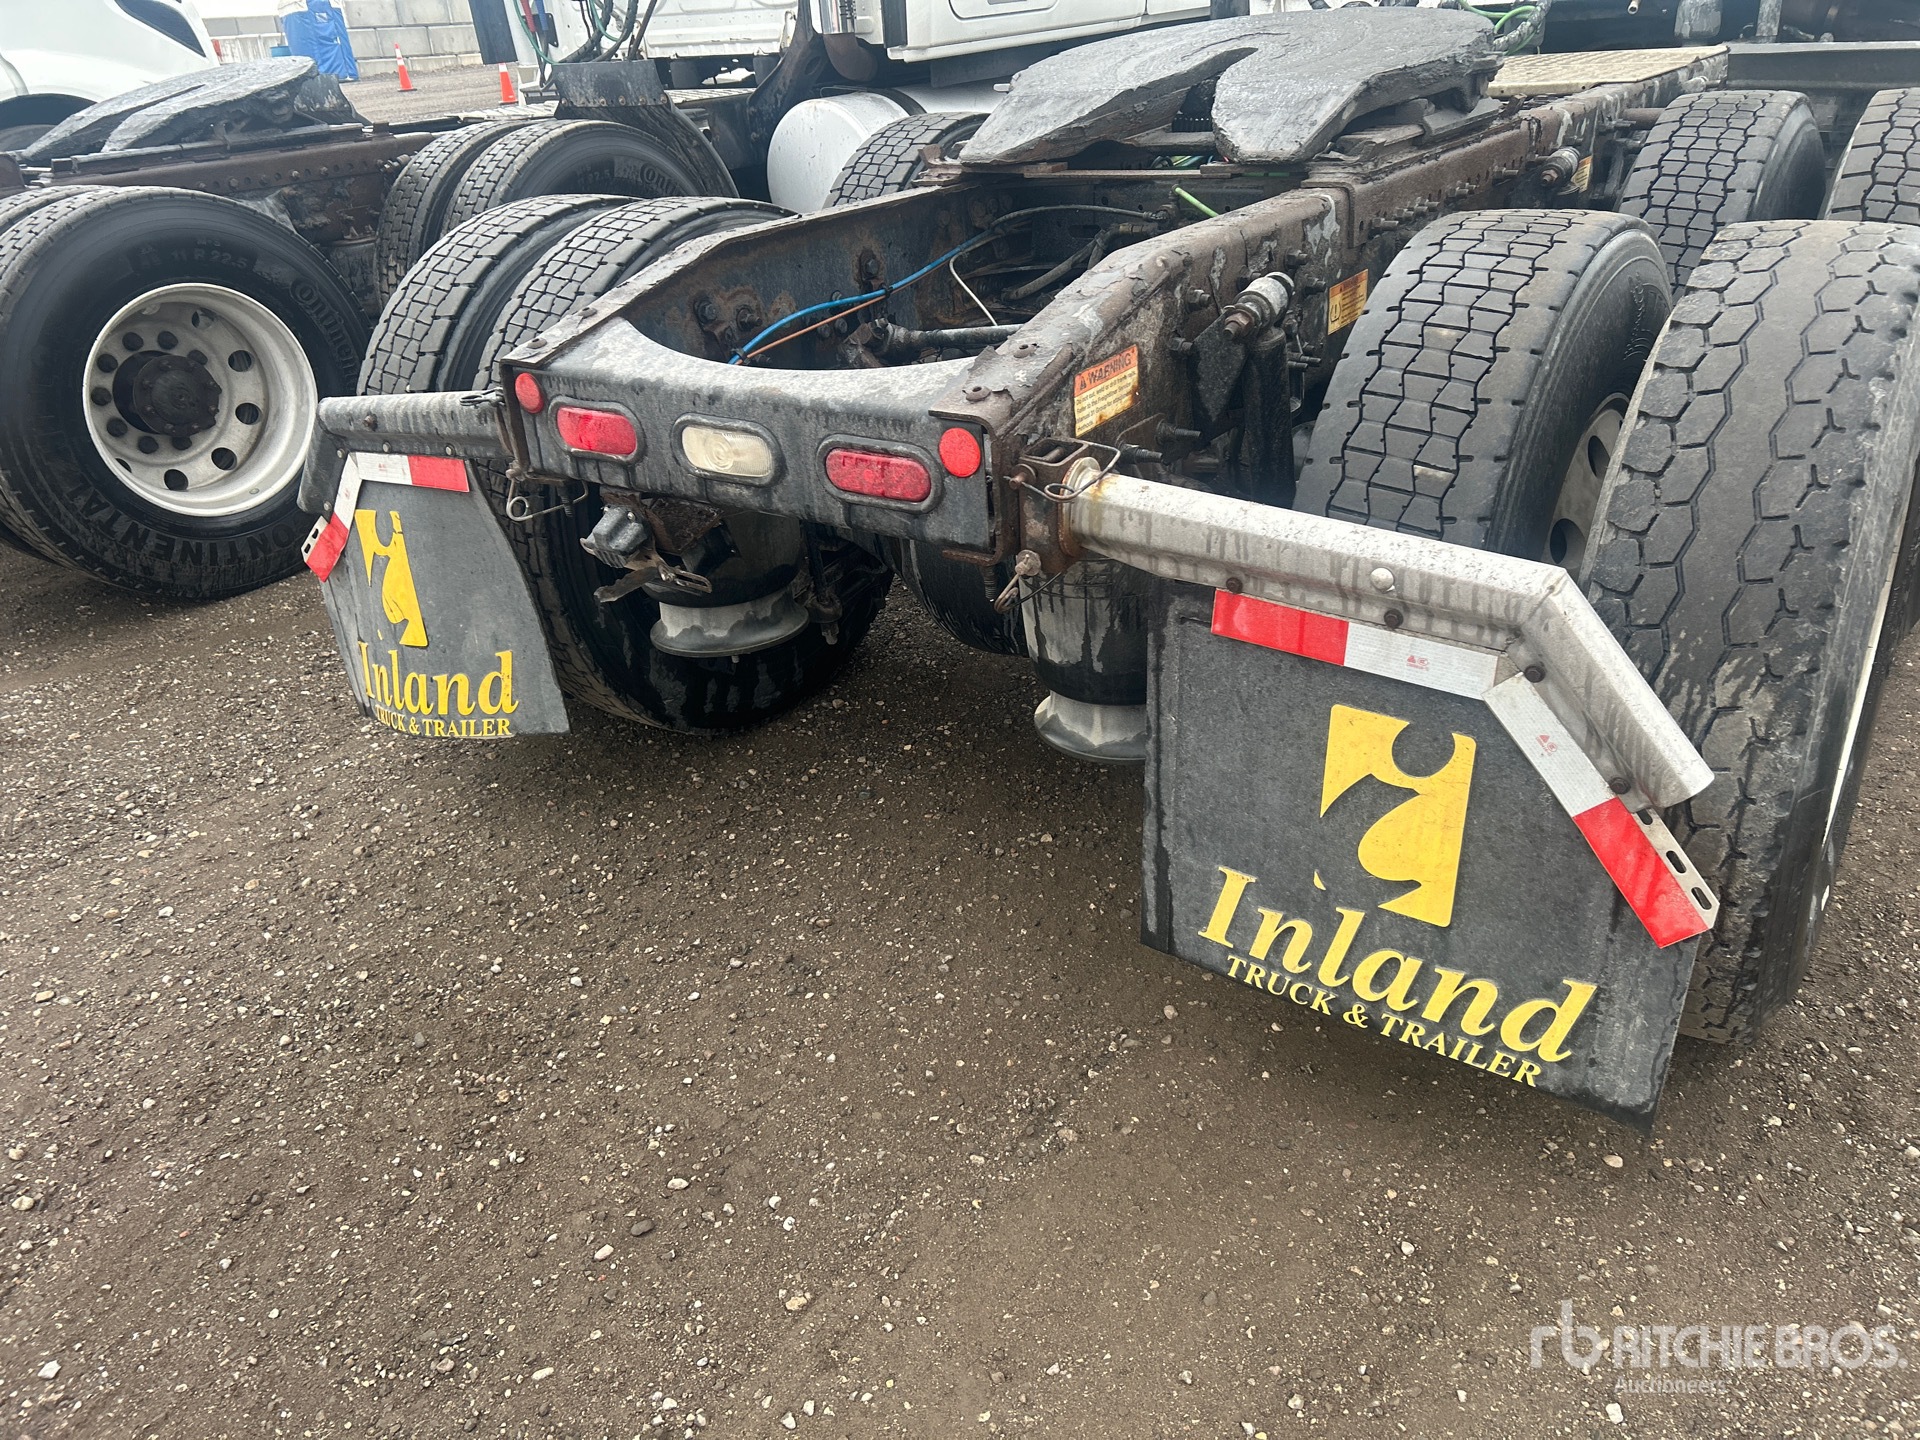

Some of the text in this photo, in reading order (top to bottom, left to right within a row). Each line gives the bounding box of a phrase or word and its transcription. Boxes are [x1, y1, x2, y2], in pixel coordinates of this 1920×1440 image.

[1088, 352, 1131, 384] WARNING
[357, 640, 519, 716] Inland
[374, 704, 512, 737] TRUCK & TRAILER
[1197, 866, 1598, 1062] Inland
[1227, 954, 1542, 1087] TRUCK & TRAILER
